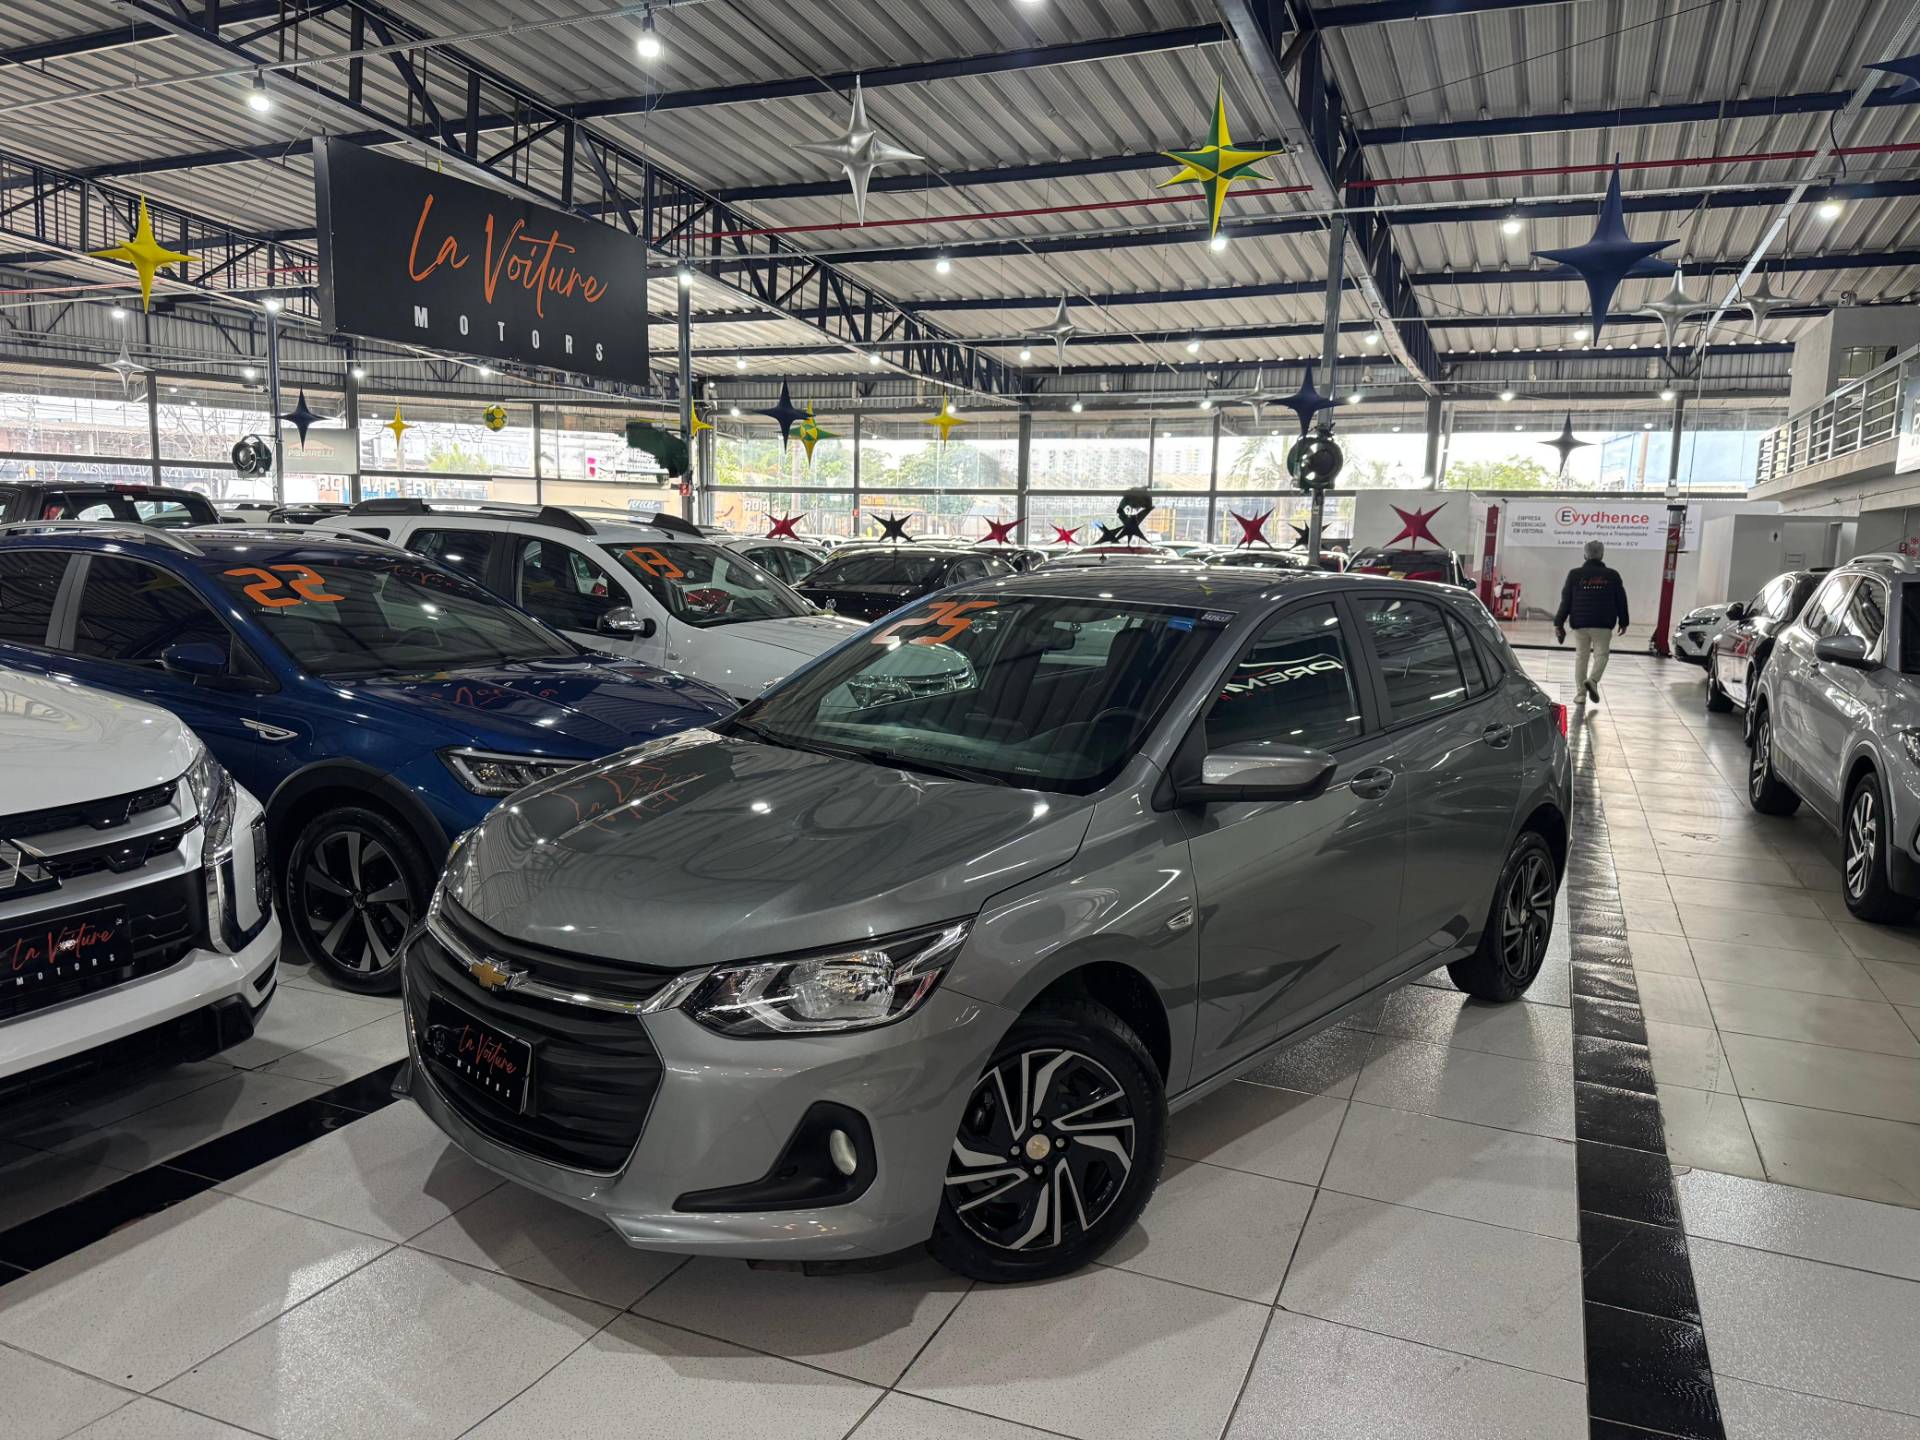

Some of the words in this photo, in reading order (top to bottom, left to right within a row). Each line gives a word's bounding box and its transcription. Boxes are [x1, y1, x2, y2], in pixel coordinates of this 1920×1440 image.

[409, 193, 470, 282] La
[484, 213, 609, 319] Voiture
[413, 305, 604, 362] MOTORS
[1560, 510, 1650, 525] Evydhence
[223, 564, 346, 608] 22
[870, 600, 1000, 645] 25
[12, 937, 41, 970] La
[47, 923, 115, 964] Vture
[16, 953, 115, 986] MOTORS
[457, 1024, 475, 1053] La
[475, 1032, 517, 1076] Voiture
